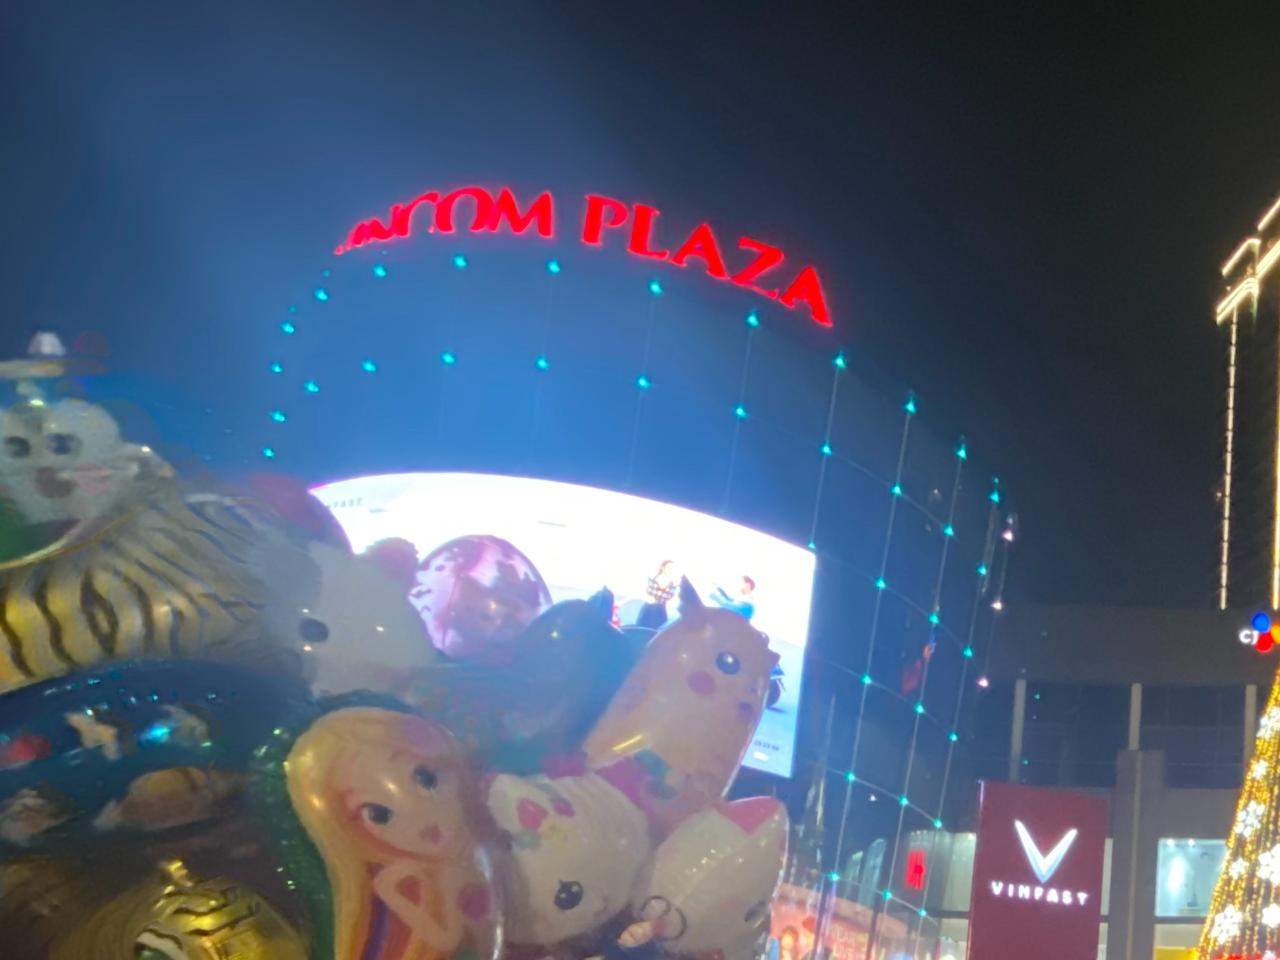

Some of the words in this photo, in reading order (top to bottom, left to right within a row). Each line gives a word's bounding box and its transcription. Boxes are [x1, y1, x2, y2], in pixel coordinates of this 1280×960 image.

[334, 185, 553, 255] NCOM
[581, 194, 833, 328] PLAZA
[990, 881, 1088, 906] VINFAST
